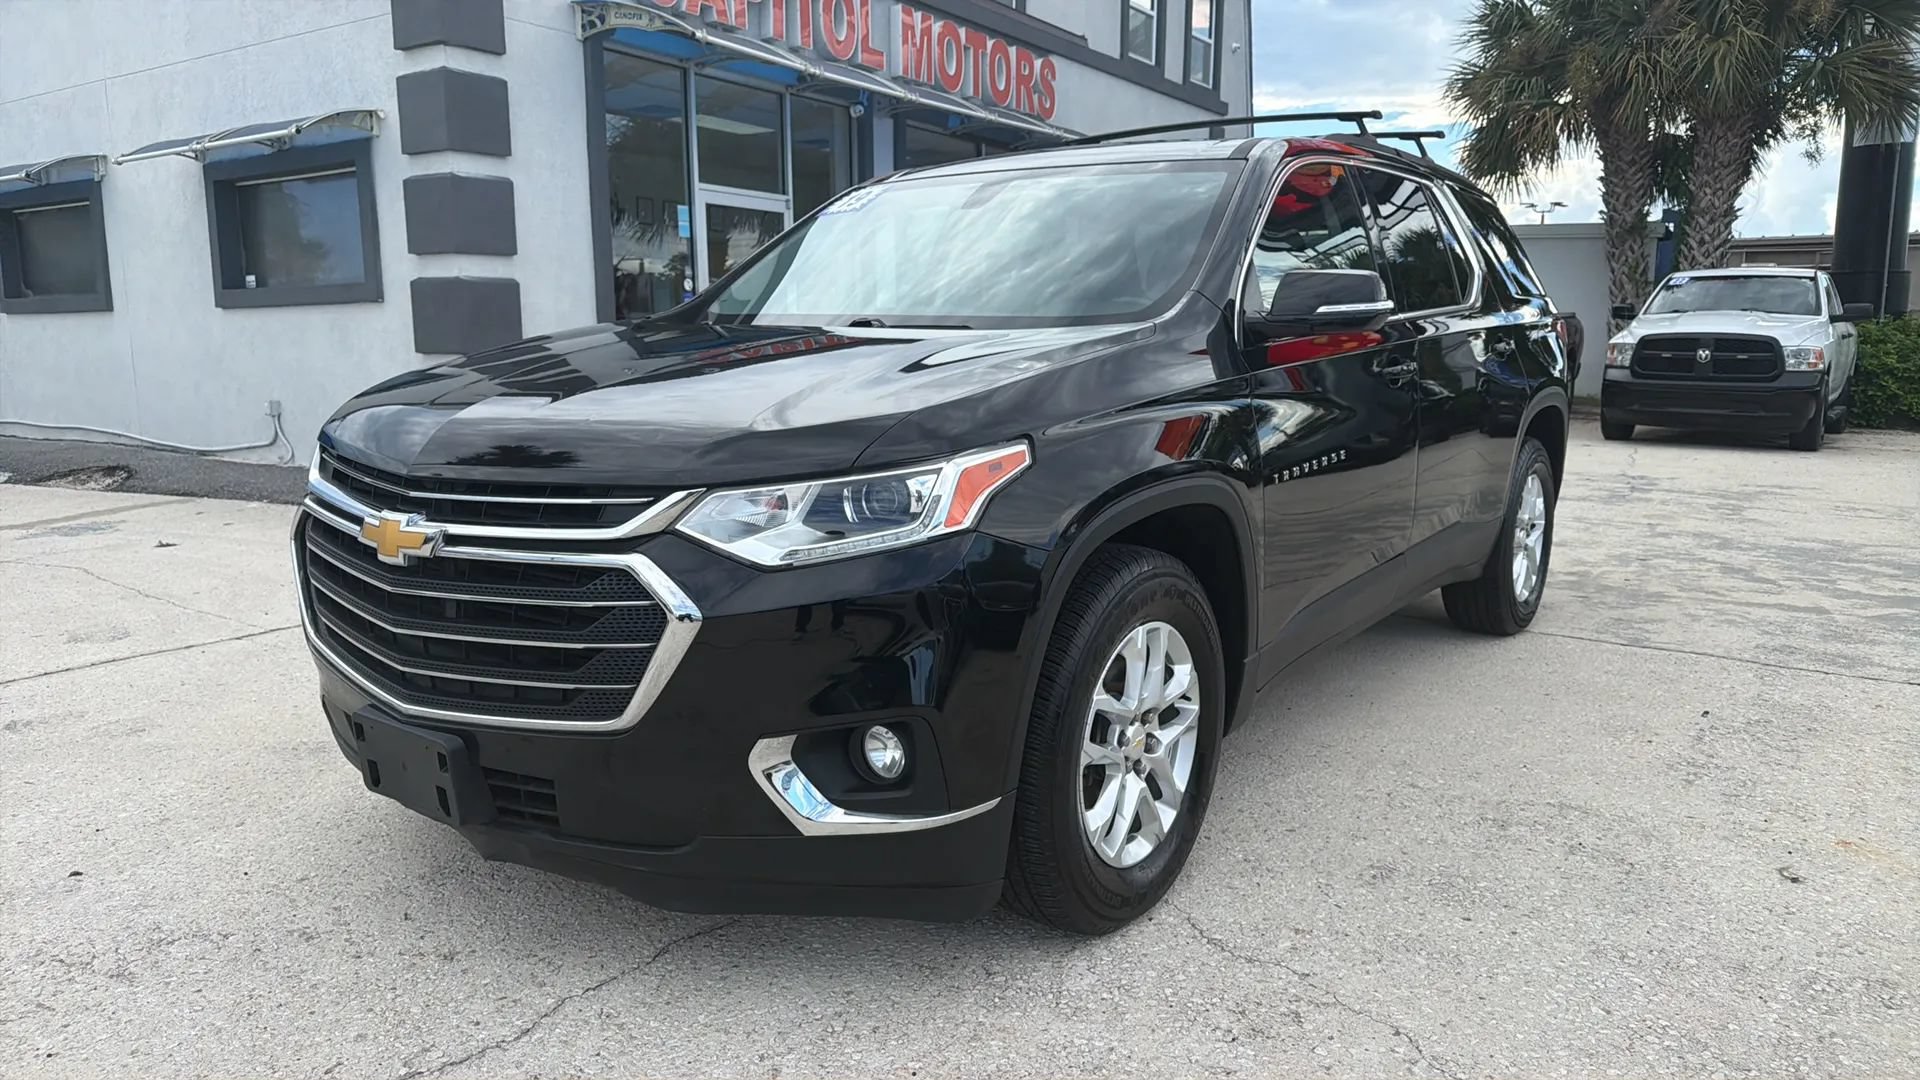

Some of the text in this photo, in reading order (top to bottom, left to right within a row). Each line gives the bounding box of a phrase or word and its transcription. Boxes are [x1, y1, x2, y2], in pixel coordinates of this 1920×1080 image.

[652, 0, 1057, 121] ITOL MOTORS
[1273, 449, 1346, 484] TRAVERSE
